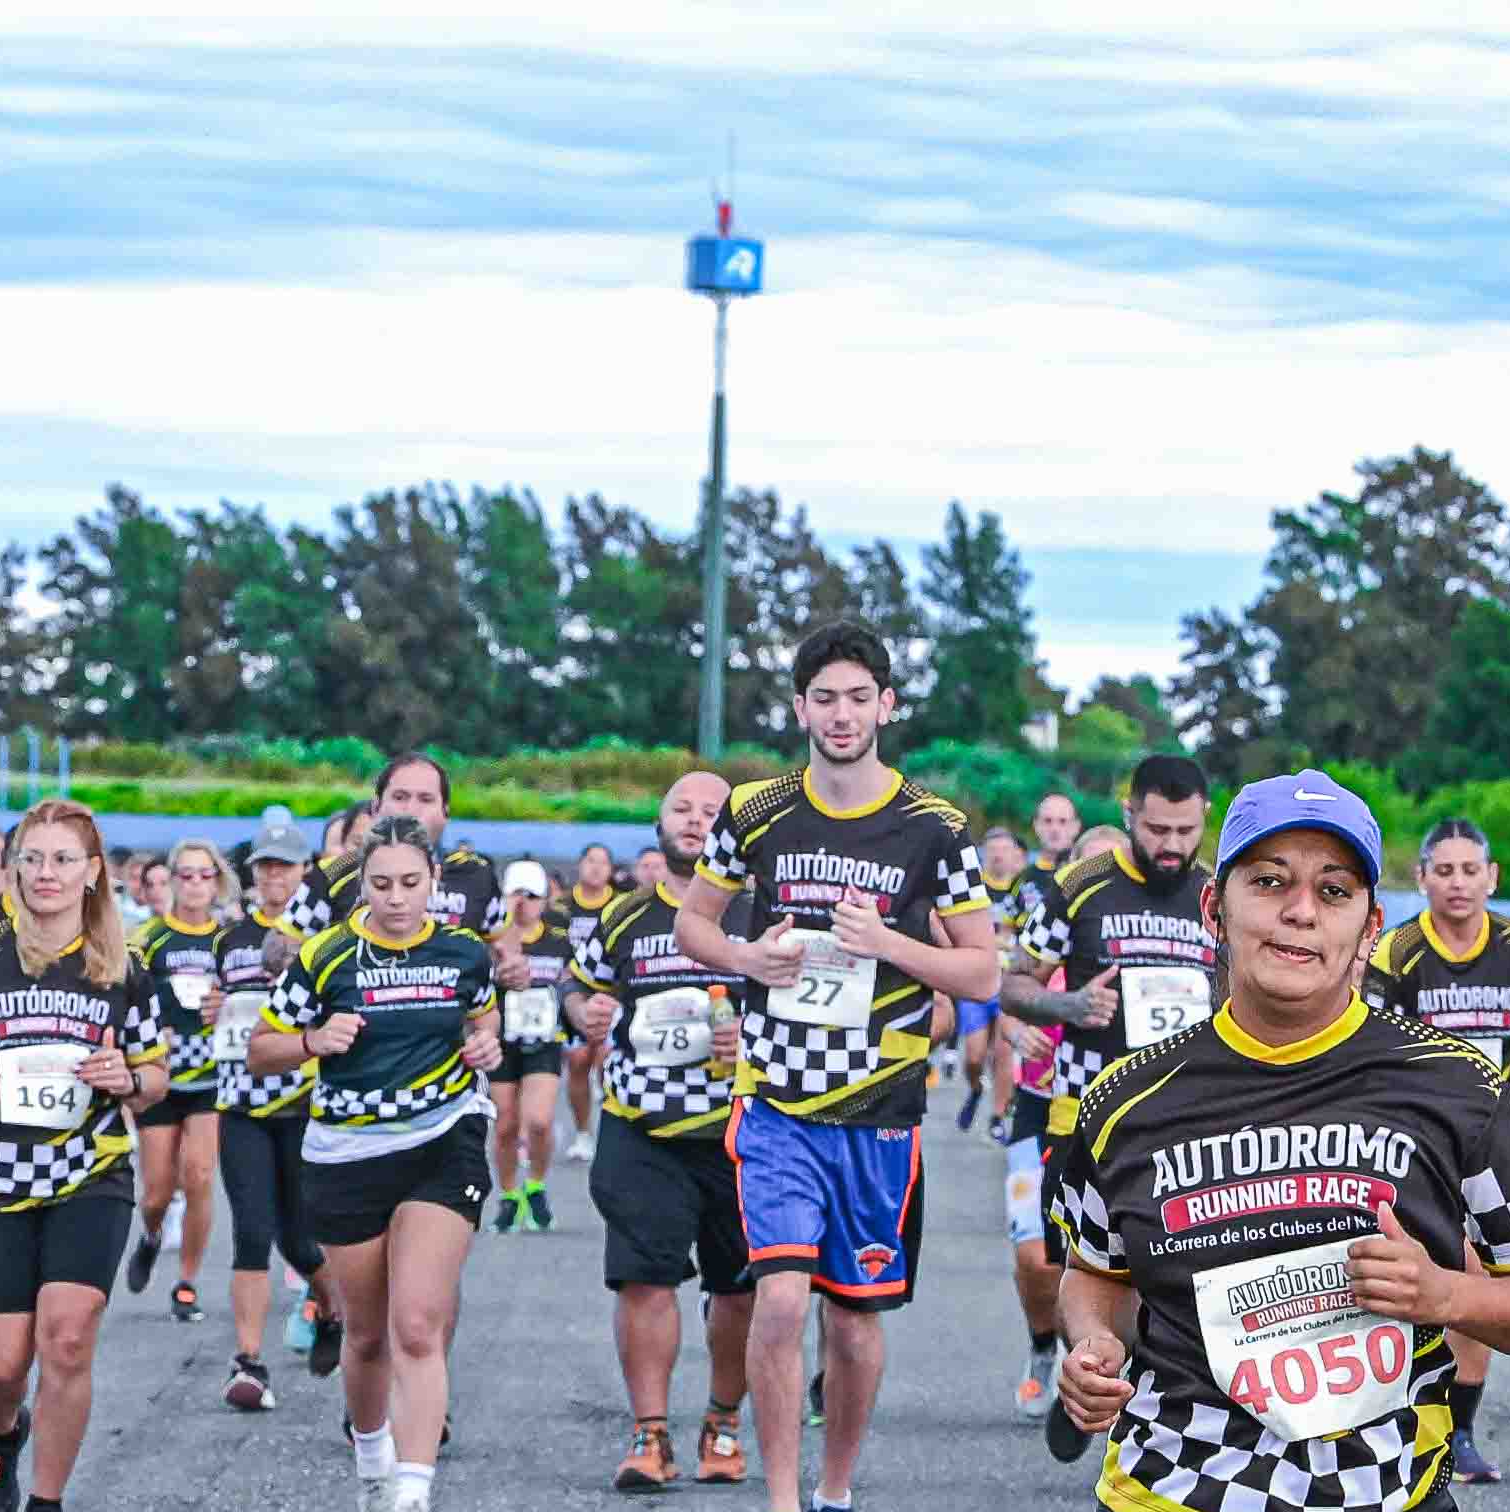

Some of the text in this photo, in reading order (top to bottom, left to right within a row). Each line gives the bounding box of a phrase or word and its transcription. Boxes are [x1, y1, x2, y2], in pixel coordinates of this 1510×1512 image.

[775, 848, 906, 895] AUTÓDROMO
[1101, 910, 1217, 946] AUTÓDROM
[797, 976, 843, 1006] 27
[1150, 1006, 1186, 1031] 52
[651, 1026, 689, 1051] 78
[17, 1085, 76, 1113] 164
[1152, 1123, 1417, 1199] AUTÓDROMO
[1187, 1176, 1372, 1223] RUNNING RACE
[1149, 1240, 1164, 1256] La
[1165, 1234, 1217, 1254] Carrera
[1221, 1228, 1241, 1246] de
[1244, 1224, 1266, 1242] los
[1271, 1218, 1323, 1239] Clubes
[1327, 1215, 1350, 1232] del
[1228, 1265, 1349, 1315] AUTÓDRO
[1256, 1292, 1355, 1329] RUNNING RACE
[1234, 1336, 1245, 1347] La
[1246, 1332, 1277, 1345] Carrera
[1278, 1326, 1289, 1337] de
[1290, 1325, 1303, 1334] los
[1303, 1319, 1331, 1332] Clubes
[1333, 1314, 1345, 1325] del
[1229, 1325, 1406, 1415] 4050
